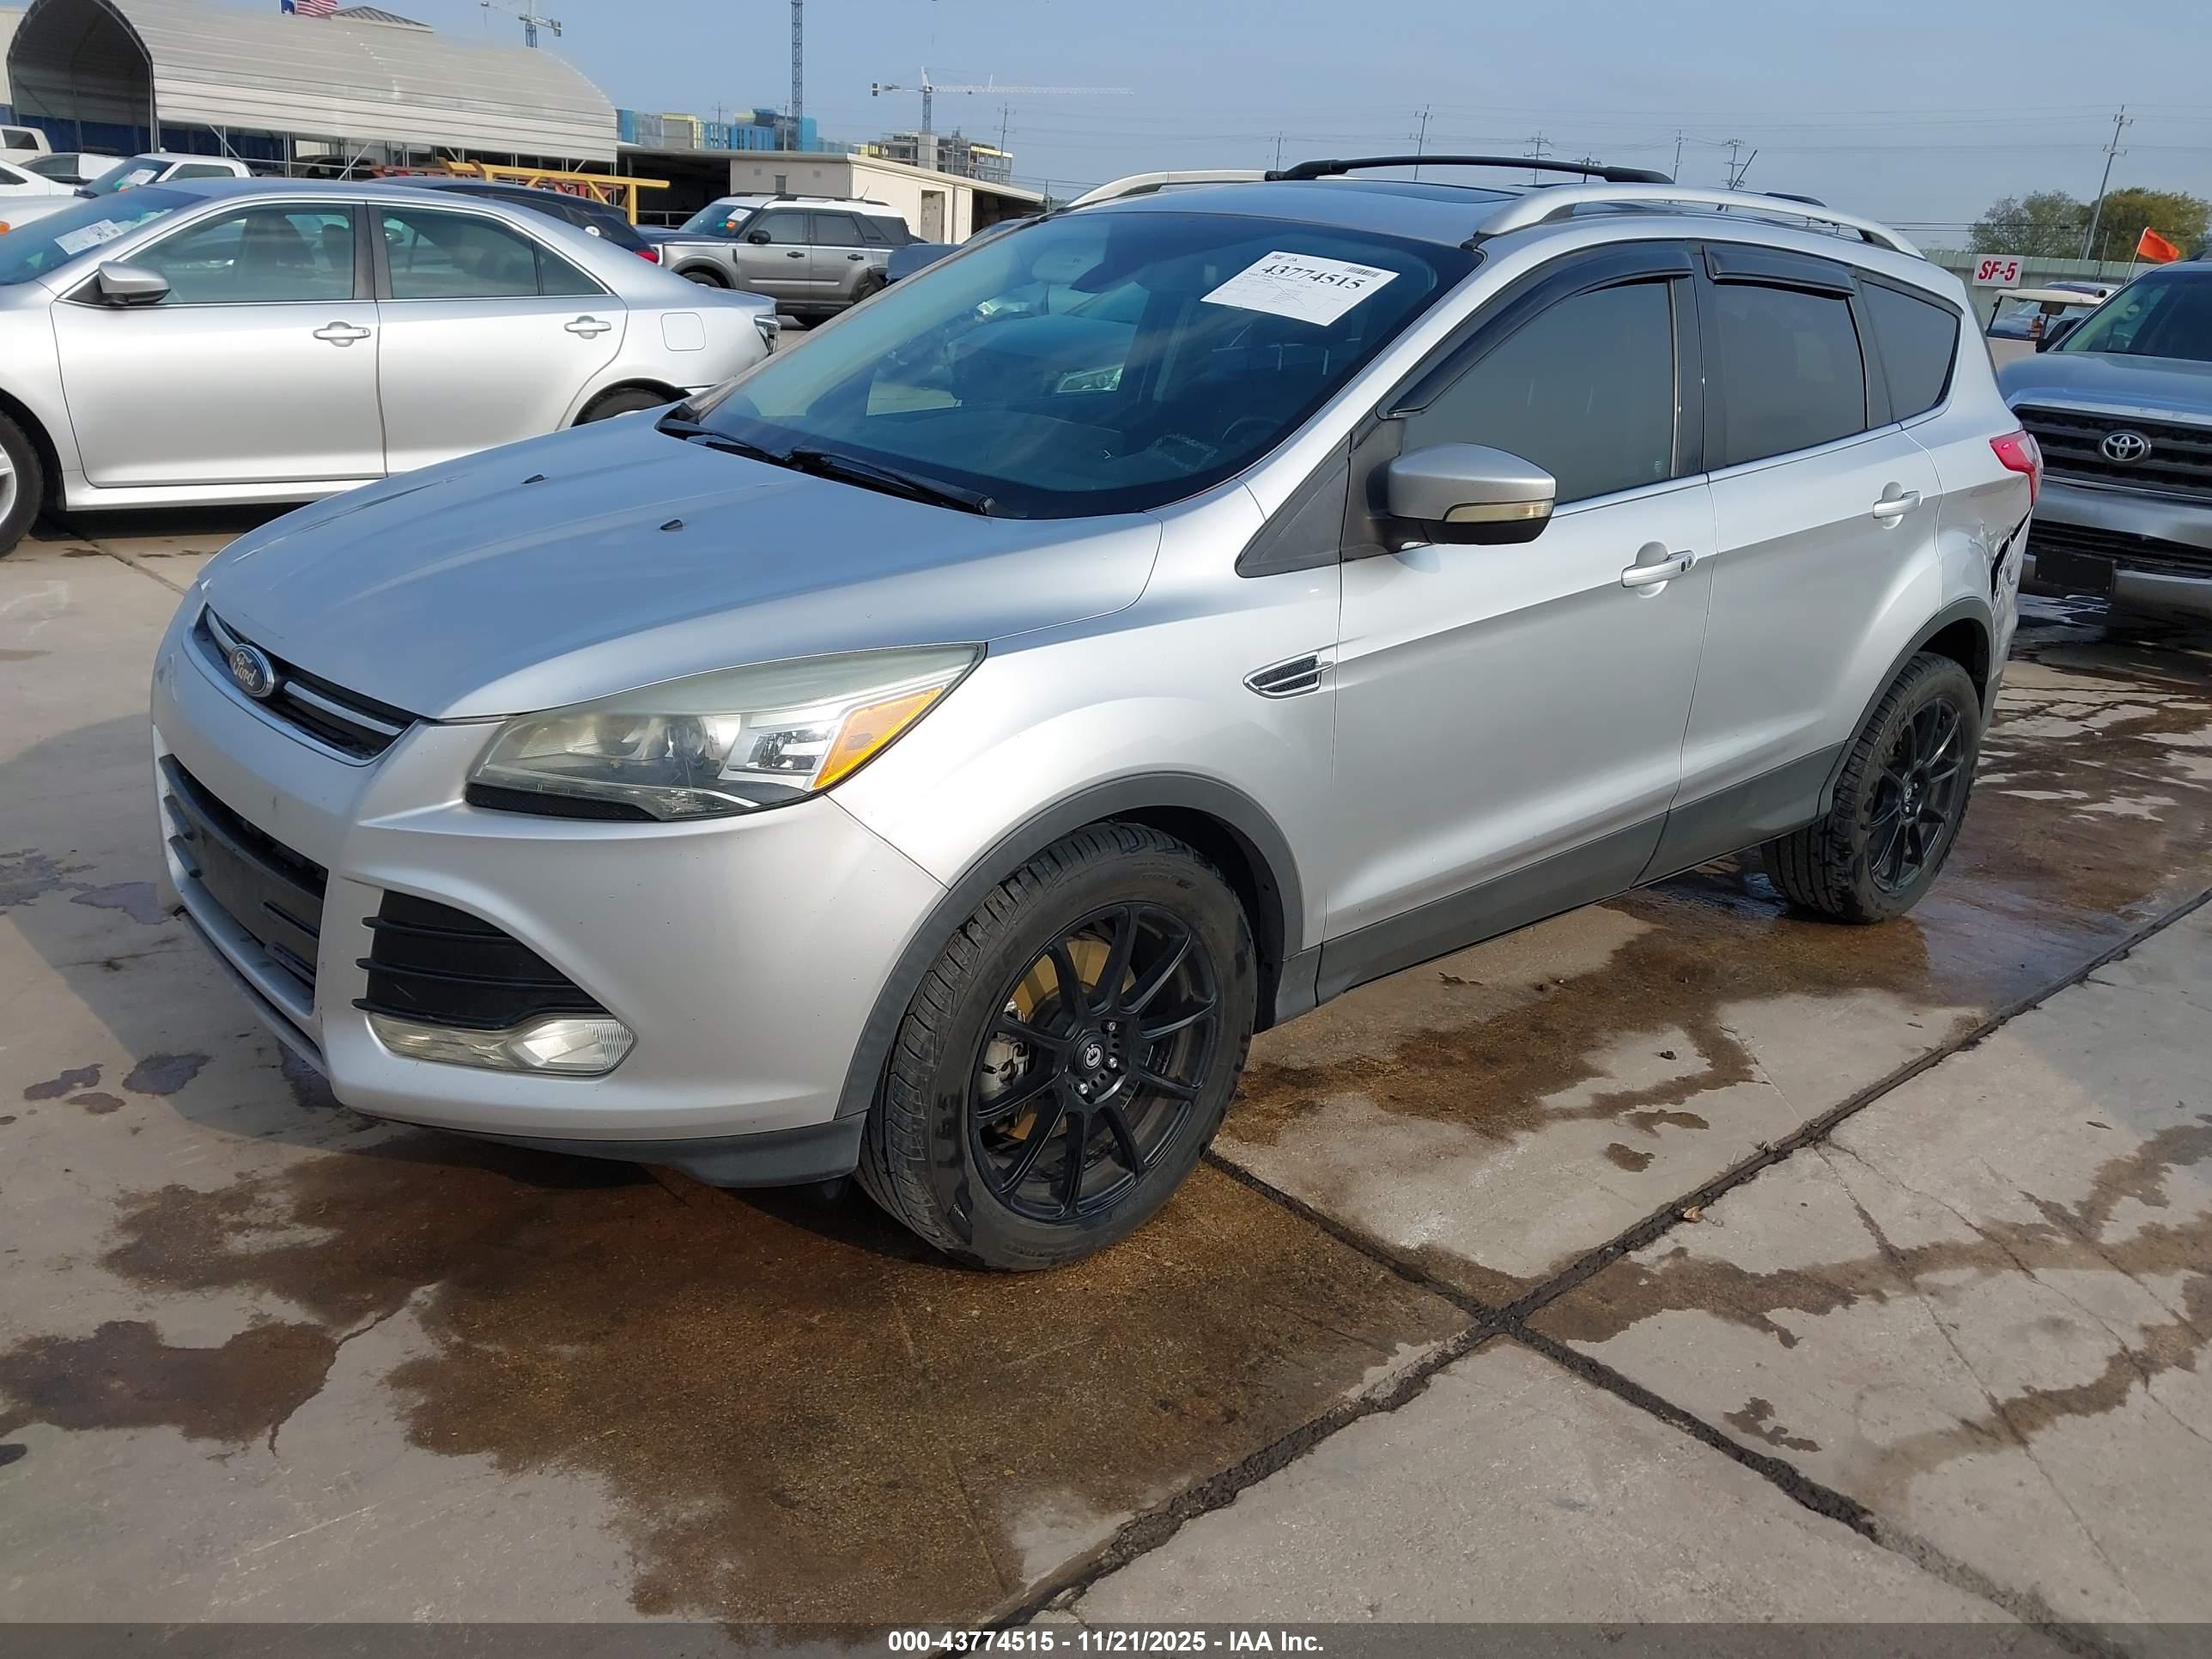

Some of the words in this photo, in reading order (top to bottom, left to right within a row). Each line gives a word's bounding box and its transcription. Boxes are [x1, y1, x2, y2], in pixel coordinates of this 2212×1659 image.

[1261, 264, 1368, 290] 43774515
[1978, 260, 2018, 281] SF-5
[233, 651, 257, 687] Ford
